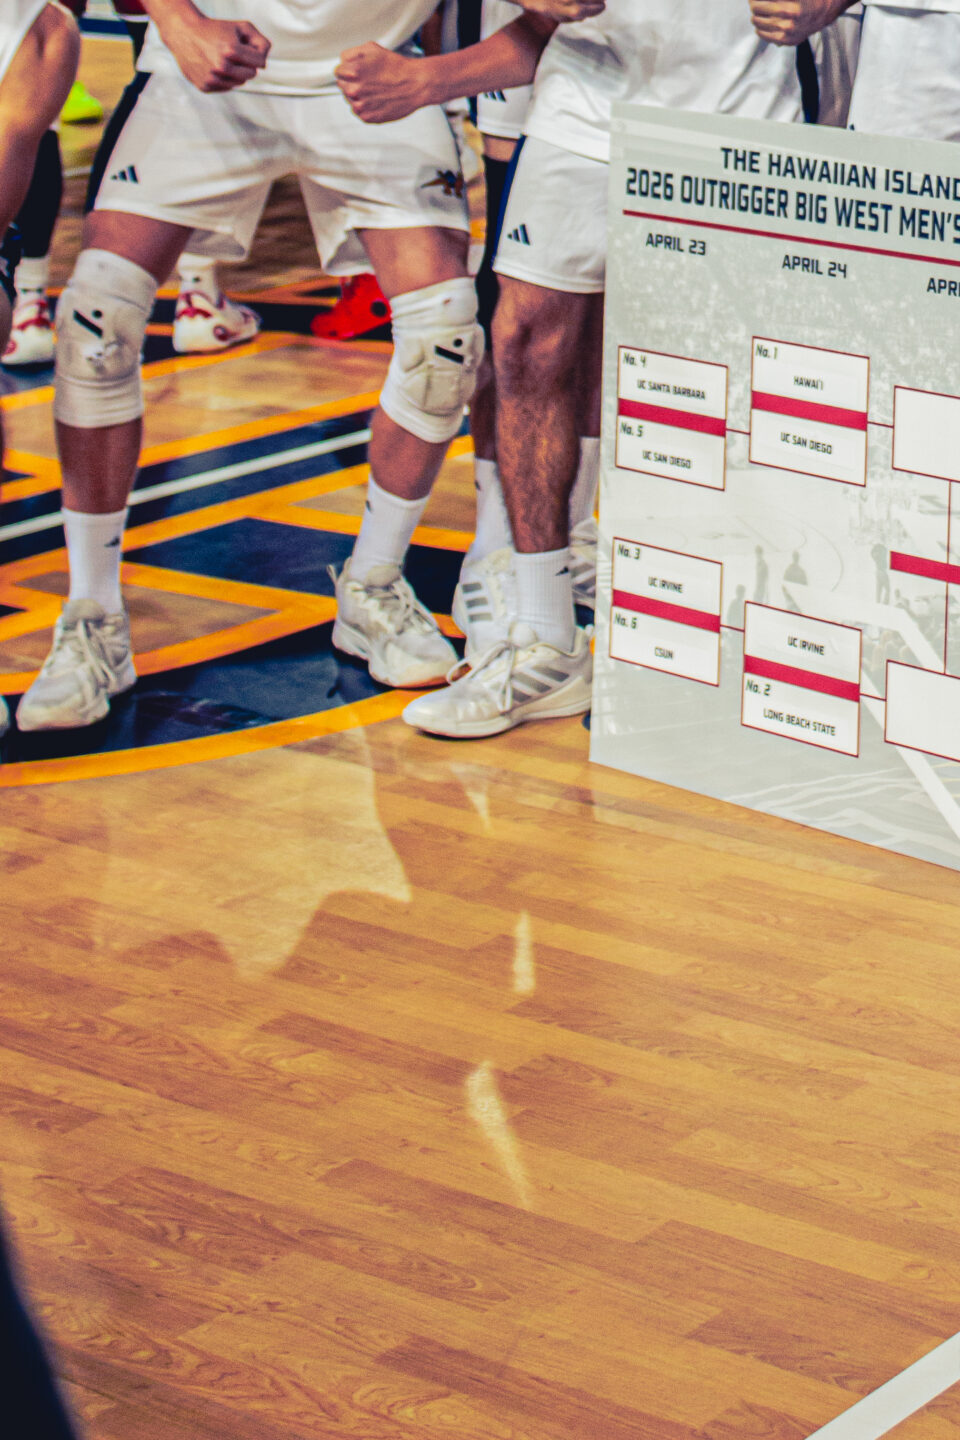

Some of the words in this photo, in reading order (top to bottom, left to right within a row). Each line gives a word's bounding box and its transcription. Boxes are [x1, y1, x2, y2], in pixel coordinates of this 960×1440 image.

[720, 147, 760, 174] THE
[768, 153, 877, 190] HAWAIIAN
[626, 167, 674, 201] 2026
[680, 175, 788, 218] OUTRIGGER
[796, 193, 827, 223] BIG
[834, 196, 892, 233] WEST
[645, 233, 684, 253] APRIL
[688, 240, 706, 255] 23
[782, 255, 823, 275] APRIL
[828, 261, 847, 278] 24
[623, 351, 637, 366] No.
[640, 354, 647, 369] 4
[755, 343, 770, 359] No.
[773, 346, 779, 360] 1
[637, 379, 646, 391] UC
[648, 380, 671, 394] SANTA
[672, 385, 706, 401] BARBARA
[621, 421, 634, 436] No.
[637, 424, 643, 438] 5
[780, 431, 790, 444] UC
[792, 434, 808, 449] SAN
[809, 439, 832, 455] DIEGO
[642, 449, 652, 461] UC
[653, 451, 668, 465] SAN
[669, 455, 691, 469] DIEGO
[617, 543, 630, 558] No.
[634, 546, 640, 560] 3
[647, 575, 657, 588] UC
[659, 578, 683, 594] IRVINE
[614, 612, 628, 628] No.
[654, 646, 674, 660] CSUN
[787, 635, 797, 649] UC
[799, 639, 825, 656] IRVINE
[746, 679, 761, 695] No.
[763, 683, 771, 697] 2
[763, 707, 784, 723] LONG
[785, 713, 811, 731] BEACH
[812, 720, 836, 737] STATE
